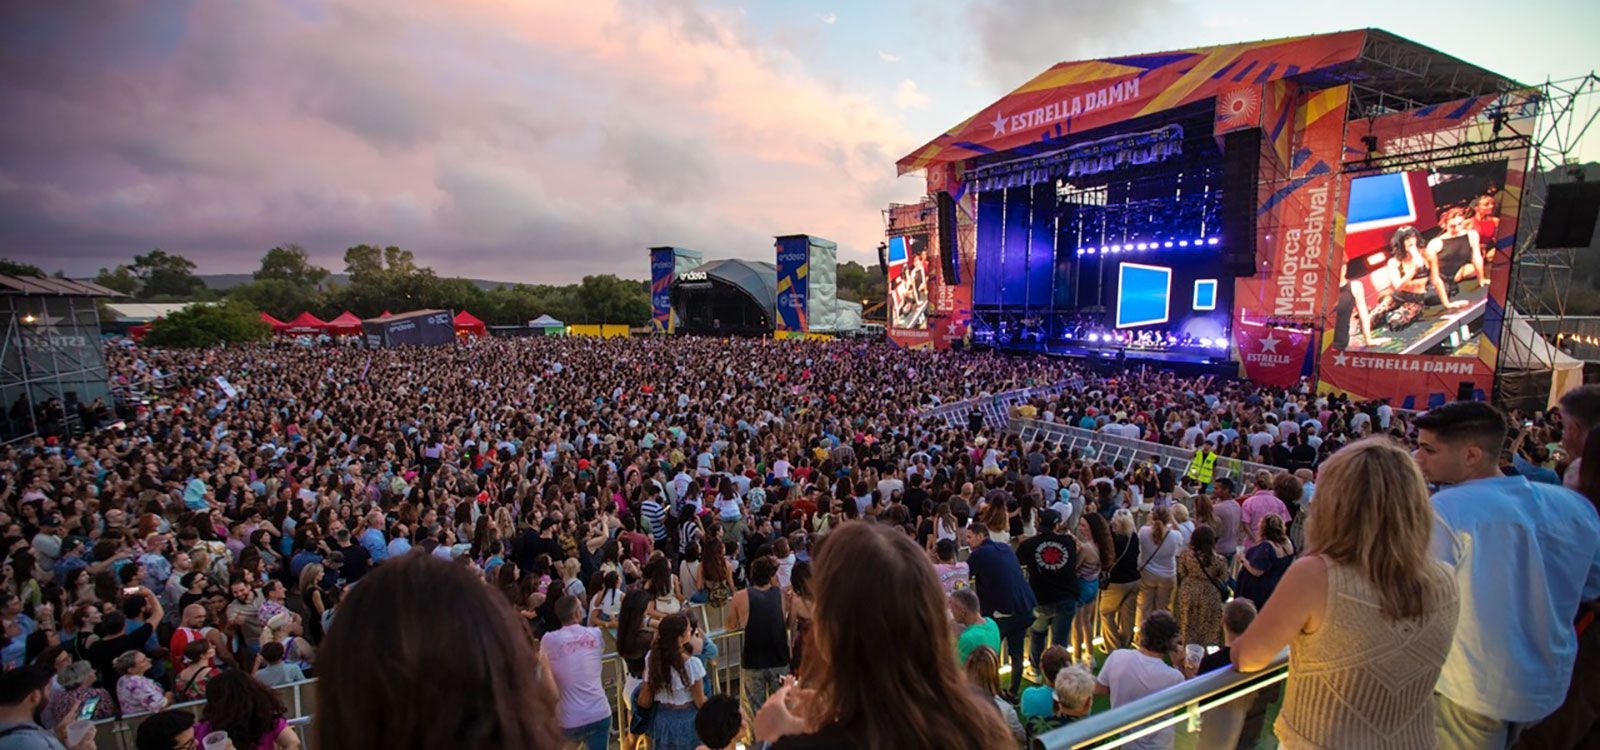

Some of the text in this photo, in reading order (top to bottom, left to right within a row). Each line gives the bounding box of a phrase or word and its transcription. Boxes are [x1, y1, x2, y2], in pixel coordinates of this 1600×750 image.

[1011, 79, 1139, 131] ESTRELLA DAMM
[1295, 181, 1329, 316] Live Festival.
[680, 271, 707, 281] endesa
[1275, 228, 1302, 316] Mallorca
[1247, 353, 1291, 364] ESTRELLA
[1351, 356, 1474, 374] ESTRELLA DAMM
